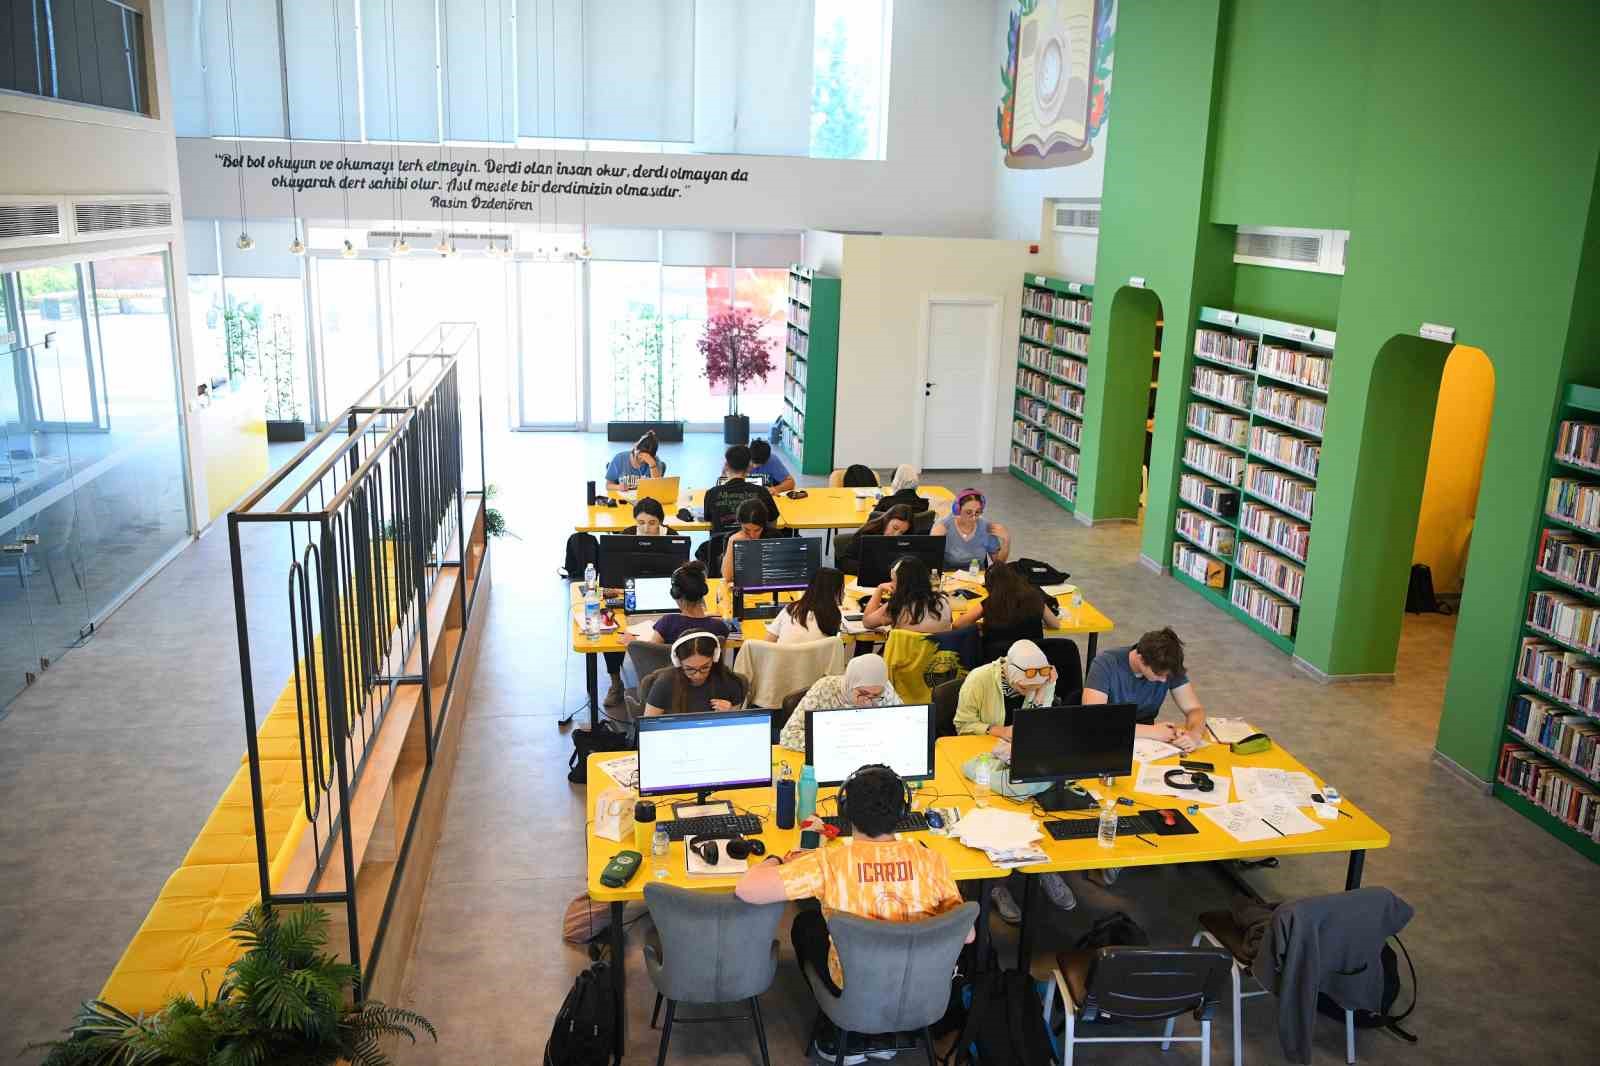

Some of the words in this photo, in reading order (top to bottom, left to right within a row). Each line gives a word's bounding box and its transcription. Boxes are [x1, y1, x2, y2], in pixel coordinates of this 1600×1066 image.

[246, 154, 266, 168] bol
[267, 155, 317, 173] okuyun
[319, 159, 334, 170] ve
[335, 157, 394, 175] okumayı
[399, 159, 424, 172] terk
[484, 158, 522, 174] Derdi
[523, 161, 553, 175] olan
[556, 161, 593, 177] insan
[632, 163, 669, 178] derdi
[670, 166, 729, 184] olmayan
[730, 168, 750, 181] da
[271, 175, 336, 192] okuyarak
[338, 175, 367, 189] dert
[368, 177, 408, 190] sahibi
[410, 177, 443, 190] olur.
[445, 177, 473, 192] Asıl
[474, 180, 519, 193] mesele
[520, 179, 541, 193] bir
[541, 180, 613, 196] derdimizin
[430, 195, 468, 209] Rasim
[857, 860, 914, 883] ICARDI
